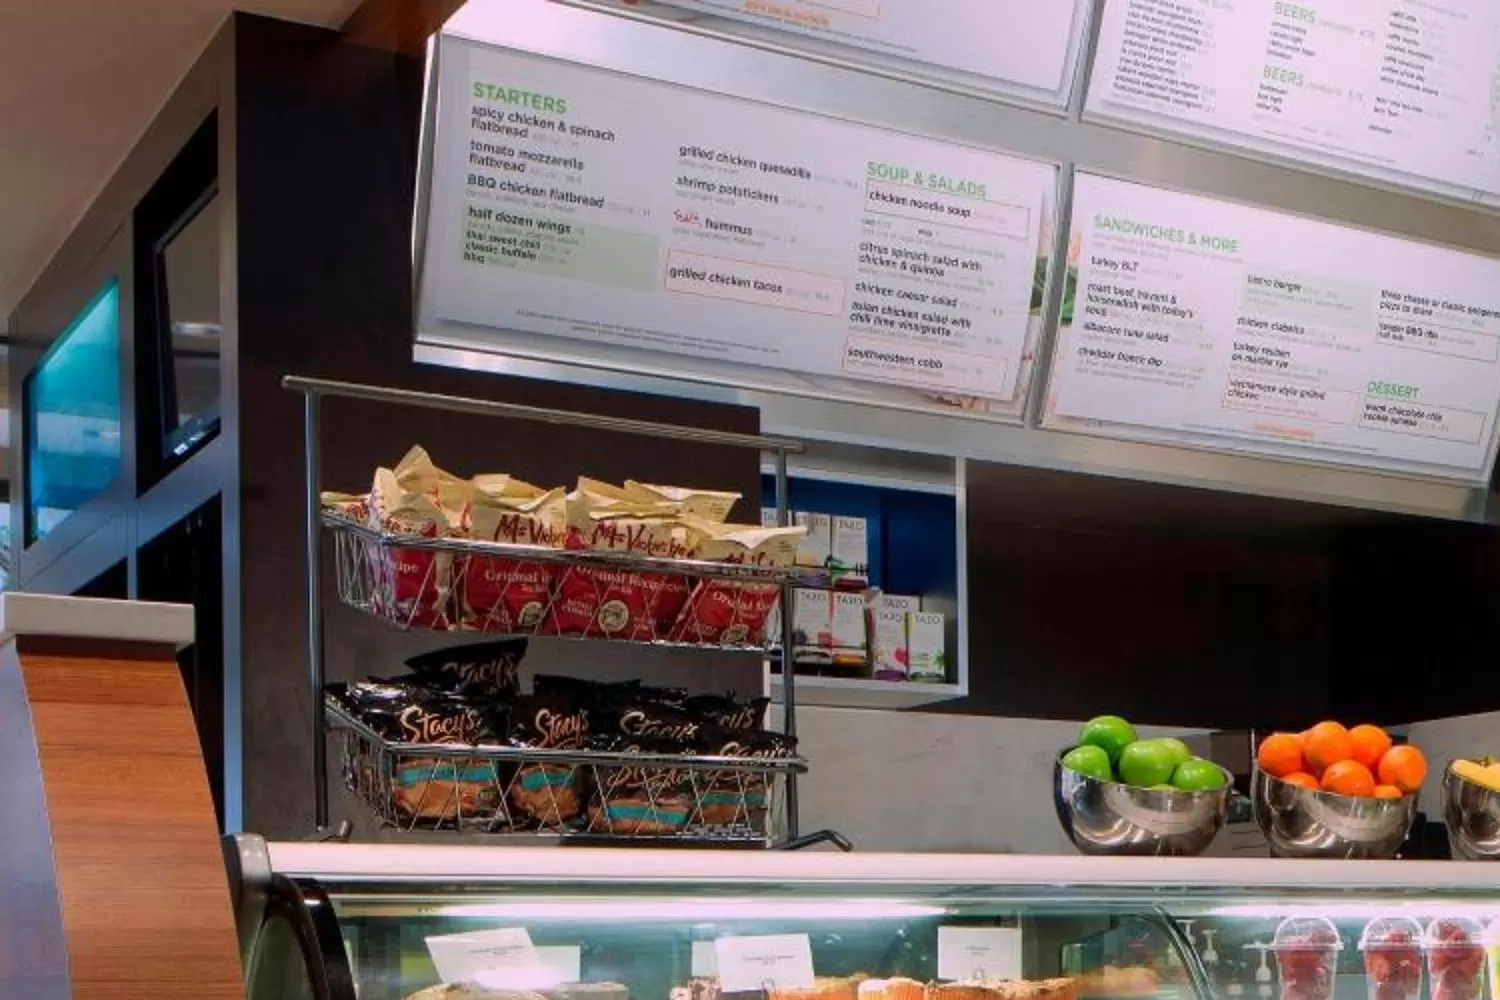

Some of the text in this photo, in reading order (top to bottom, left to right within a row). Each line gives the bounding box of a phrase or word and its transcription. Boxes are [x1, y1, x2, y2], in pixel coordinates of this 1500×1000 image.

[472, 81, 568, 115] STARTERS
[471, 117, 529, 138] flatbread
[472, 104, 504, 121] spicy
[507, 111, 555, 132] chicken
[557, 121, 566, 132] &
[569, 124, 615, 142] spinach
[468, 153, 526, 173] flatbread
[469, 139, 515, 157] tomato
[519, 149, 584, 171] mozzarella
[679, 145, 714, 162] grilled
[716, 151, 757, 169] chicken
[467, 173, 497, 189] BBQ
[499, 178, 547, 197] chicken
[549, 187, 605, 208] flatbread
[676, 175, 716, 193] shrimp
[718, 183, 779, 204] potstickers
[867, 161, 987, 196] SOUP & SALADS
[869, 189, 971, 218] chicken noodle soup
[468, 206, 493, 220] half
[496, 211, 533, 227] dozen
[536, 219, 571, 235] wings
[705, 217, 753, 236] hummus
[1094, 213, 1185, 244] SANDWICHES
[1187, 232, 1197, 245] &
[1200, 234, 1241, 252] MORE
[858, 252, 897, 269] chicken
[899, 259, 907, 271] &
[859, 241, 983, 273] citrus spinach salad with
[1091, 255, 1140, 272] turkey BLT
[669, 266, 706, 281] grilled
[708, 271, 750, 288] chicken
[753, 277, 783, 294] tacos
[855, 281, 894, 297] chicken
[1087, 282, 1111, 295] roast
[851, 301, 972, 330] asian chicken salad with
[847, 348, 915, 367] southwestern
[917, 356, 943, 370] cobb
[1233, 341, 1260, 355] turkey
[1367, 380, 1420, 398] DESSERT
[914, 612, 942, 625] TAZO
